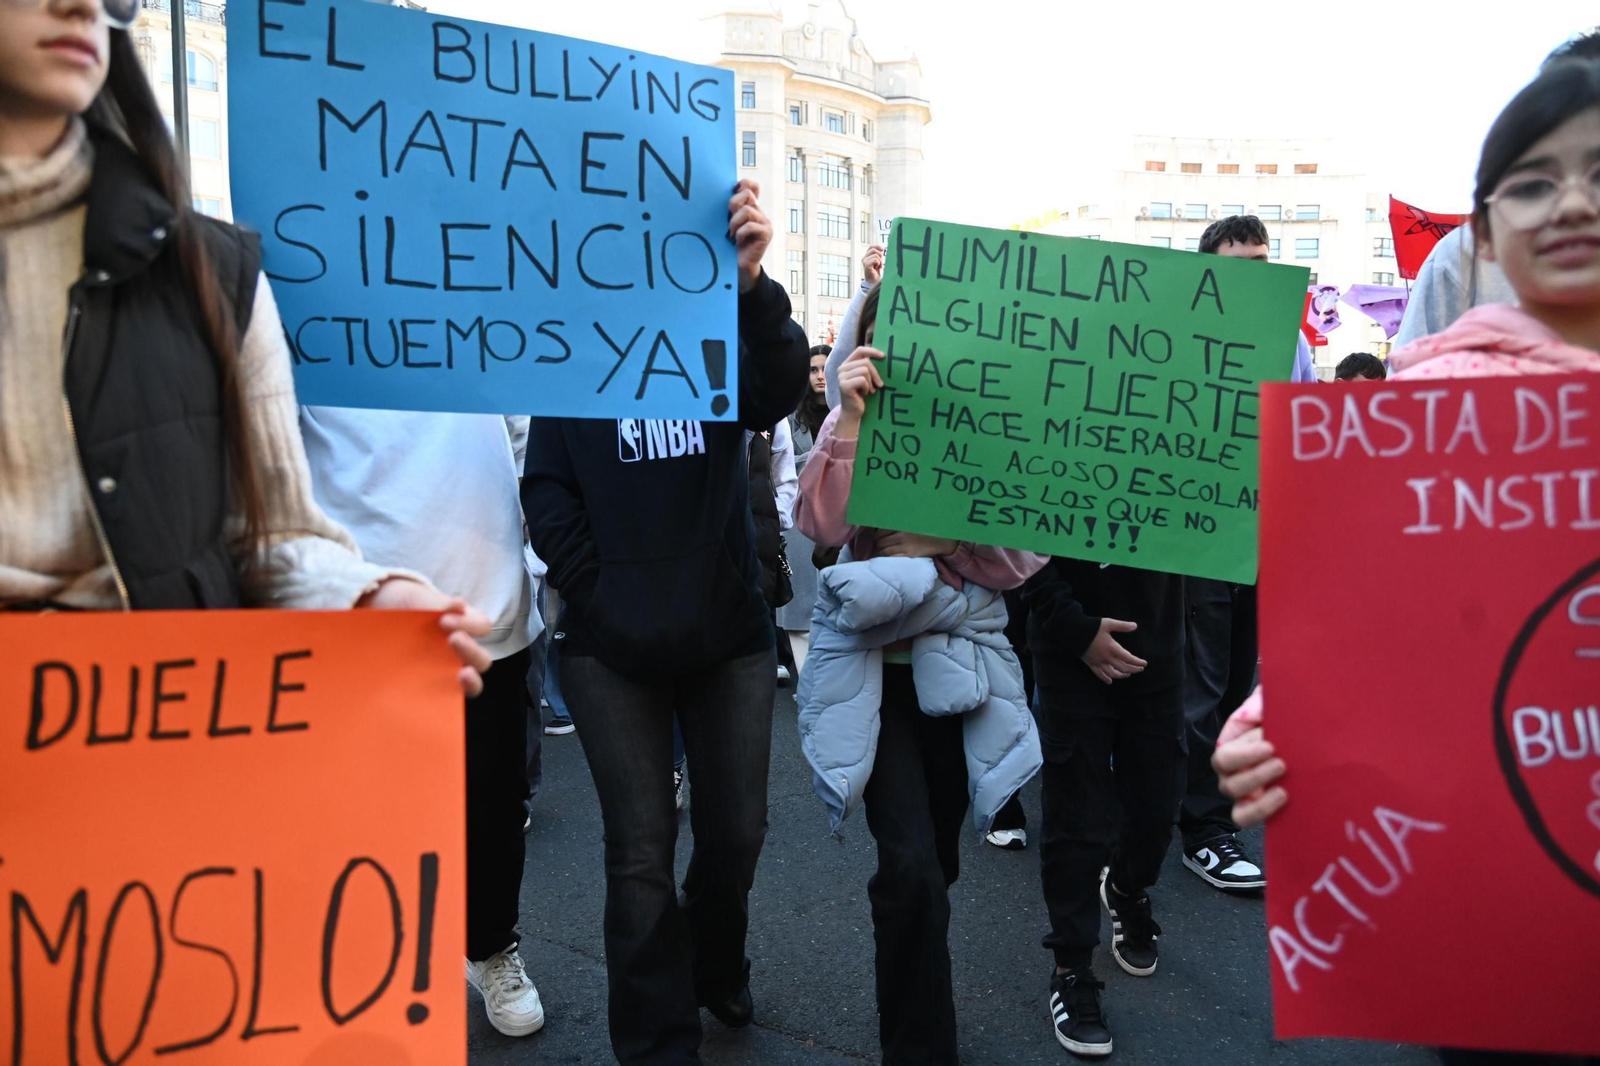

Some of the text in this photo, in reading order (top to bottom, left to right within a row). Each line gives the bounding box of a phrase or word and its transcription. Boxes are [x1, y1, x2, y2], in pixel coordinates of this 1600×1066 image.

[258, 0, 366, 71] EL
[317, 98, 690, 202] MATA EN
[1190, 268, 1225, 316] A
[592, 321, 731, 418] YA!
[886, 336, 1259, 440] HACE FUERTE
[1107, 323, 1173, 364] NO
[1192, 333, 1256, 384] TE
[645, 418, 706, 460] NBA
[876, 385, 916, 428] TE
[931, 398, 1031, 443] HACE
[1291, 382, 1588, 461] BASTA DE
[866, 456, 1217, 534] POR TODOS LOS QUE NO
[871, 429, 921, 456] NO
[942, 440, 983, 468] AL
[1006, 450, 1119, 491] ACOSO
[26, 649, 313, 750] DUELE
[1269, 806, 1447, 992] ACTÚA
[0, 852, 440, 1066] MOSLO!
